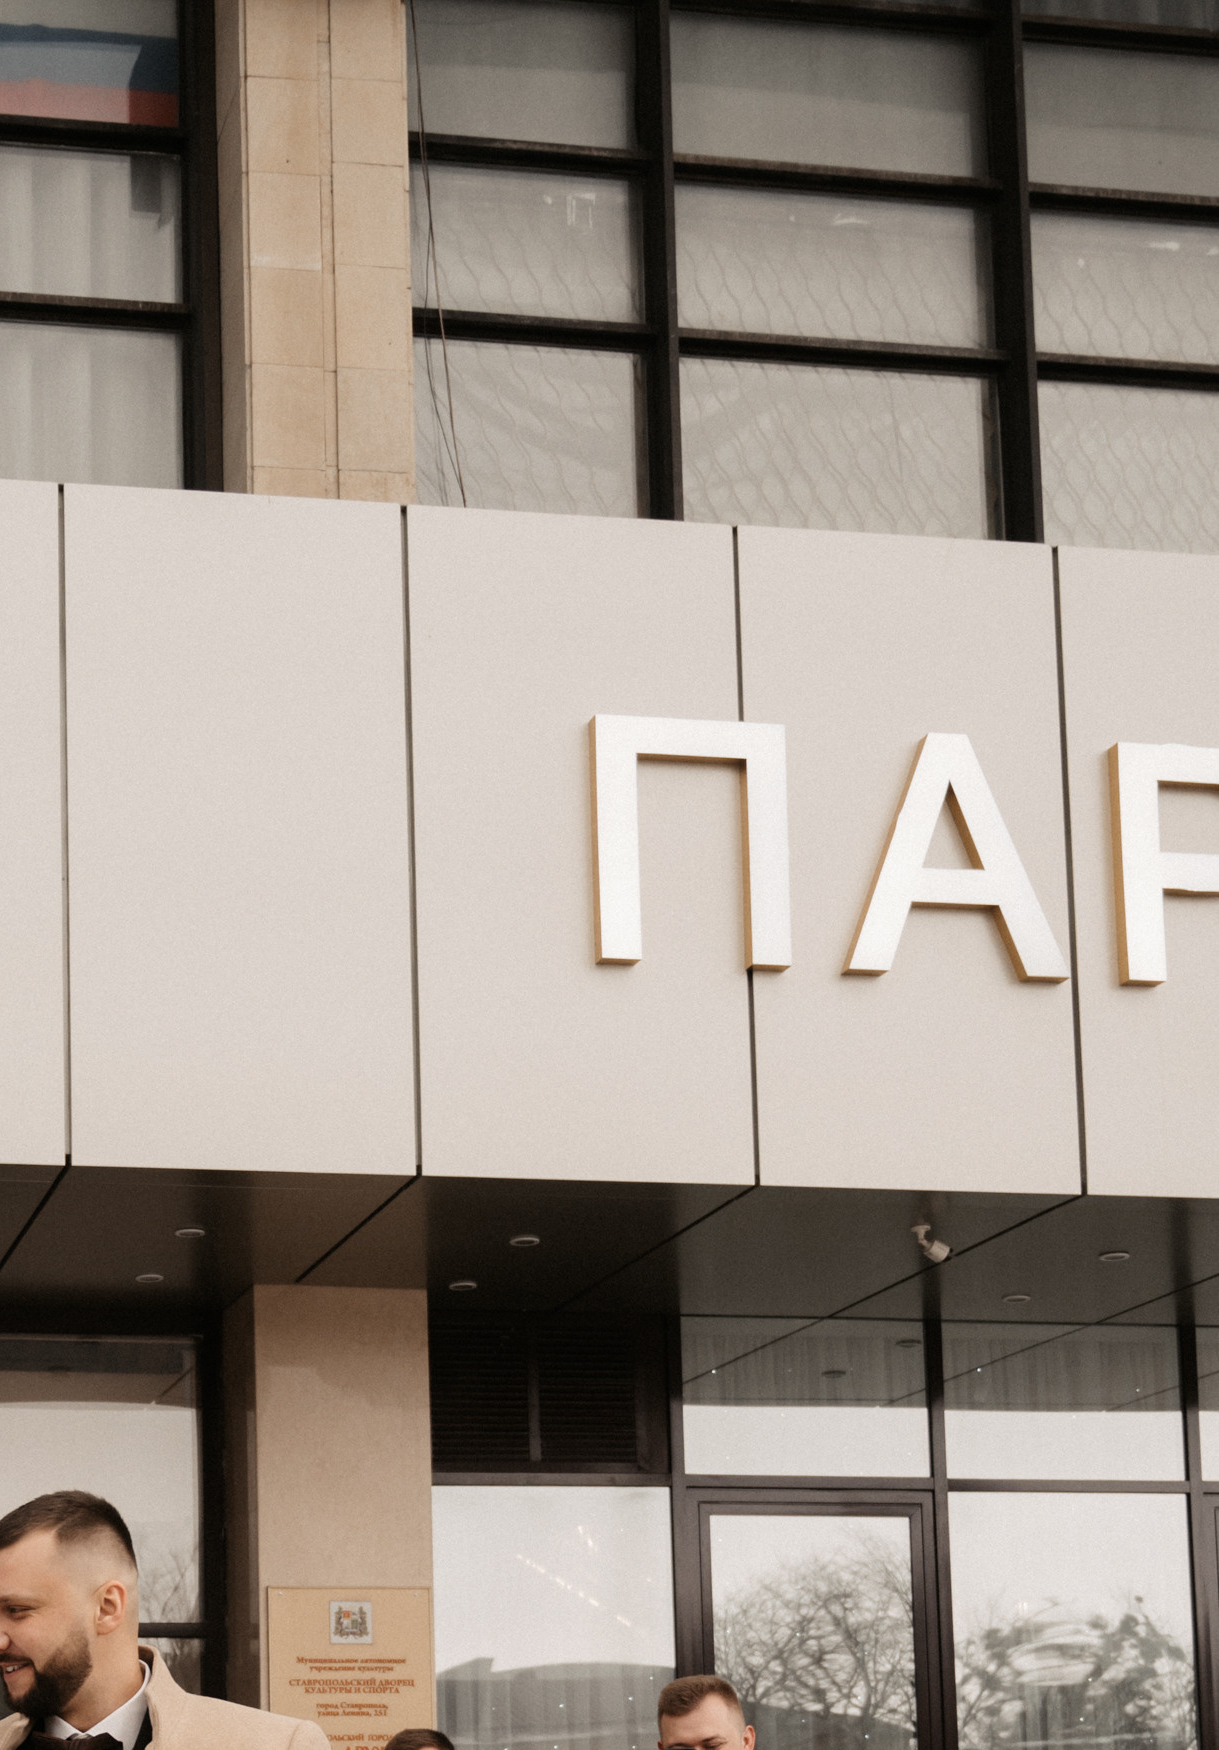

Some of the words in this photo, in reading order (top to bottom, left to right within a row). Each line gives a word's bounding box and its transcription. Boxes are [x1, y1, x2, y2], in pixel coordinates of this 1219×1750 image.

[357, 1665, 394, 1673] культуры
[289, 1678, 376, 1686] СТАВРОПОЛЬСКИЙ
[378, 1679, 414, 1687] ДВОРЕЦ
[304, 1686, 353, 1694] КУЛЬТУРЫ
[354, 1686, 362, 1694] И
[362, 1686, 400, 1694] СПОРТА
